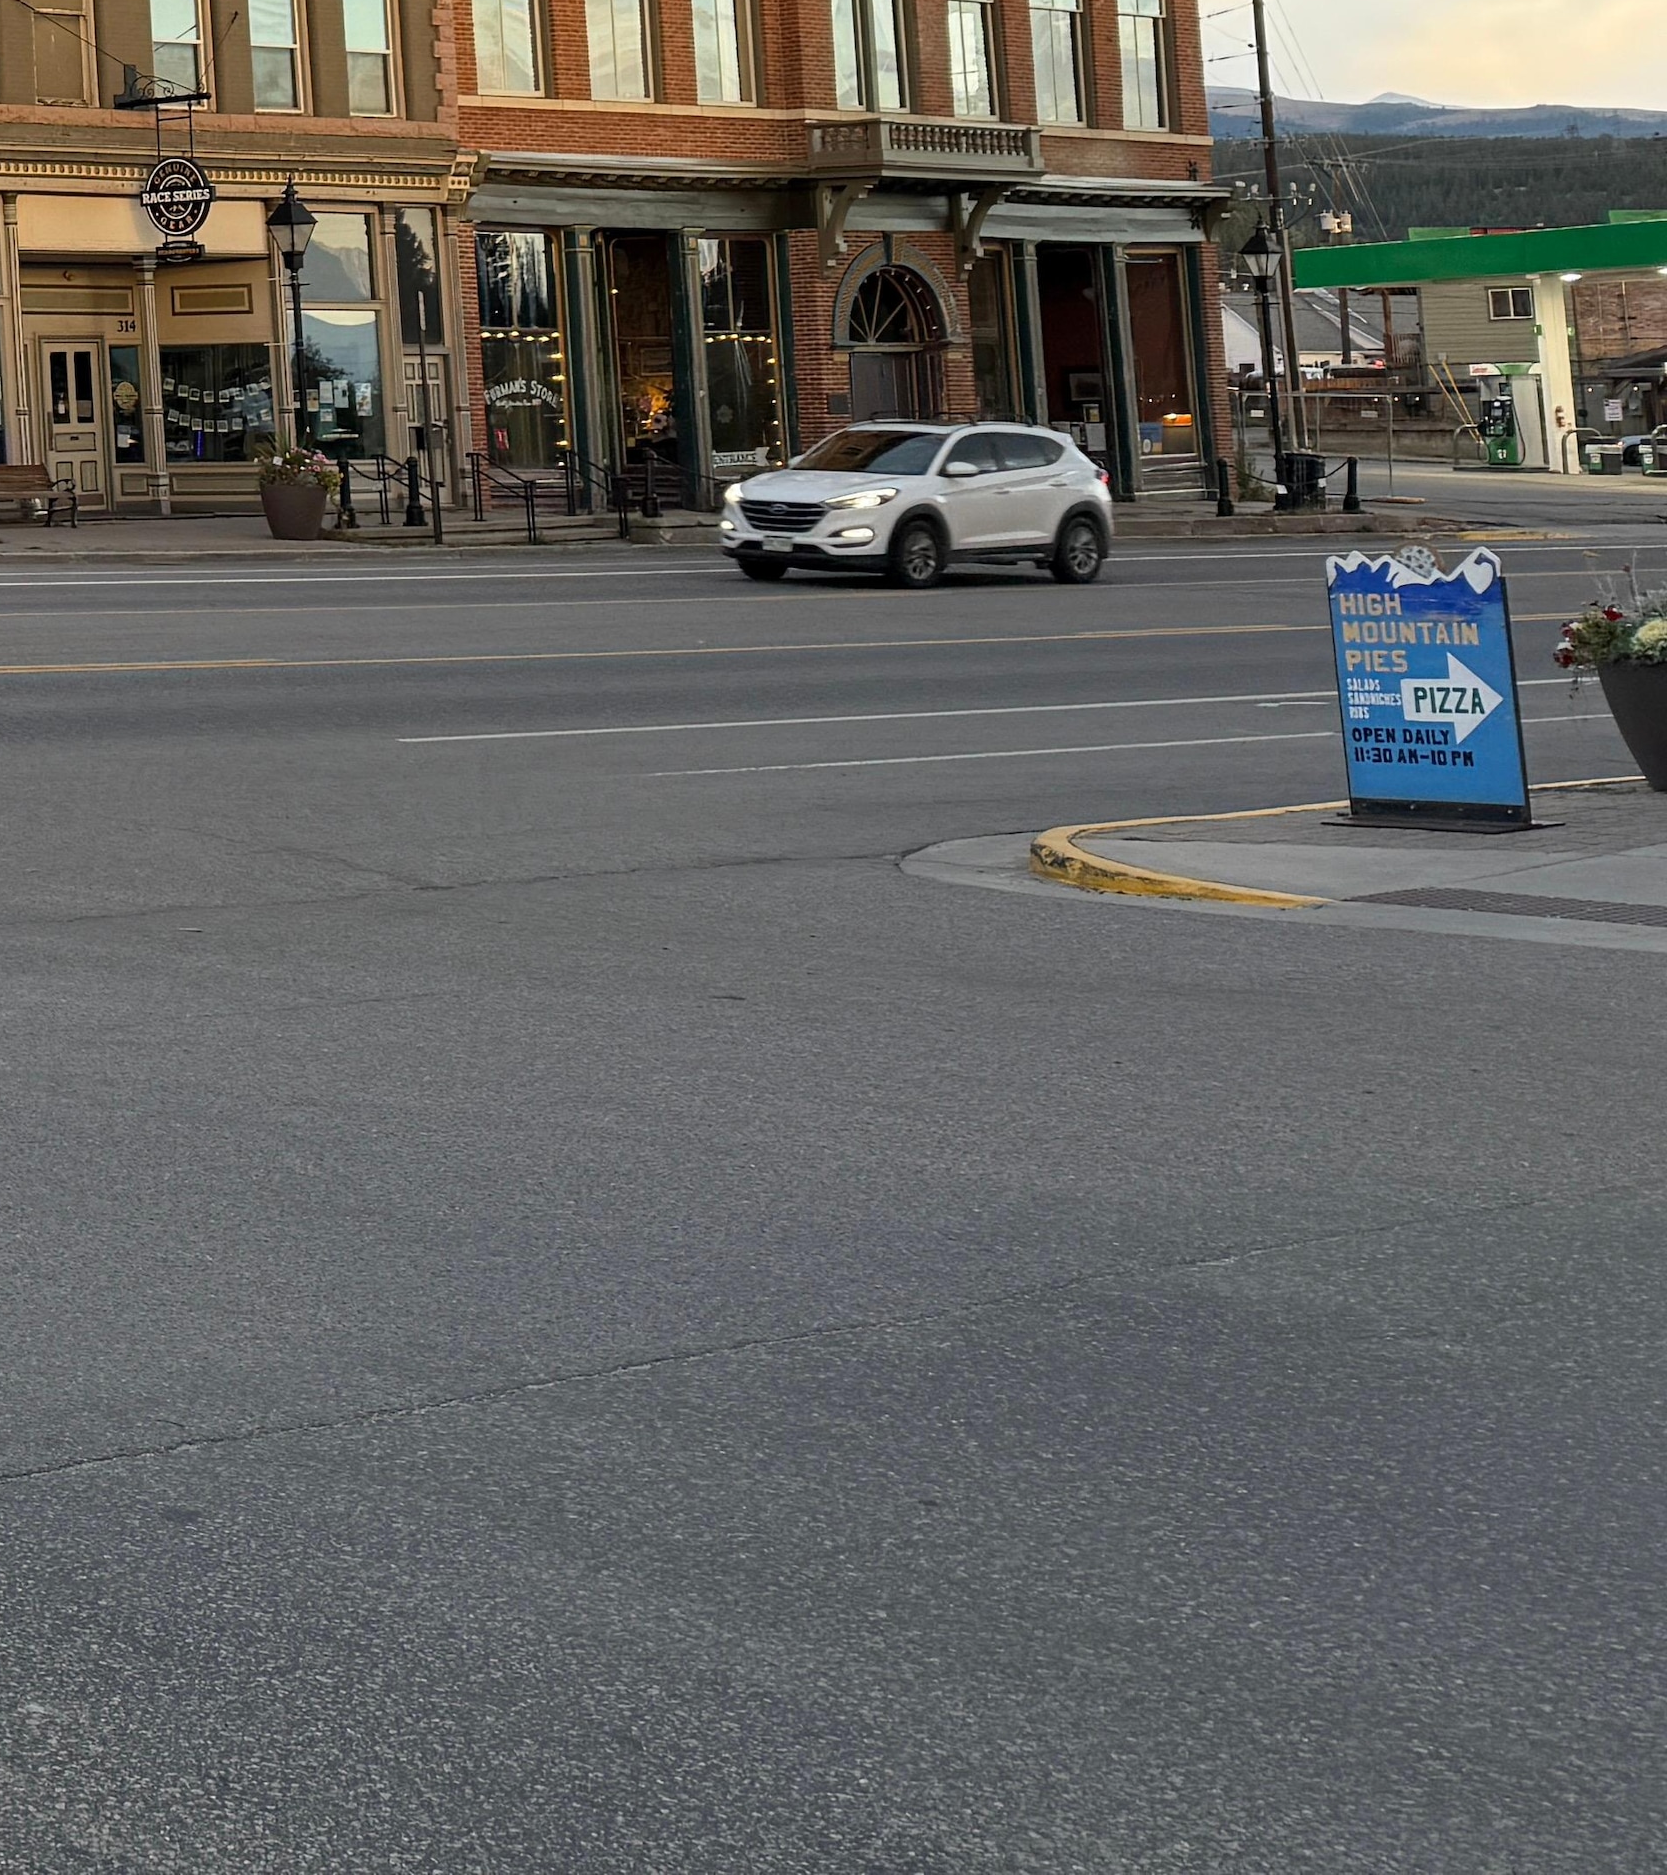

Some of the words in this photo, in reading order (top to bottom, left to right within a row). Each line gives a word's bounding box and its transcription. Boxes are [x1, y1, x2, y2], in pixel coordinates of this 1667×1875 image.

[142, 191, 171, 205] RACE
[172, 188, 211, 202] SERIES
[160, 215, 194, 230] GEAR
[117, 320, 136, 333] 314
[483, 376, 527, 406] FURMAN'S
[530, 380, 559, 409] STORE
[1339, 592, 1403, 617] HIGH
[1342, 621, 1480, 646] MOUNTAIN
[1345, 649, 1409, 674] PIES
[1346, 677, 1381, 692] SALADS
[1413, 686, 1486, 715] PIZZA
[1352, 727, 1397, 744] OPEN
[1402, 728, 1450, 746] DAILY
[1354, 746, 1394, 764] 11:30
[1451, 750, 1475, 768] PM
